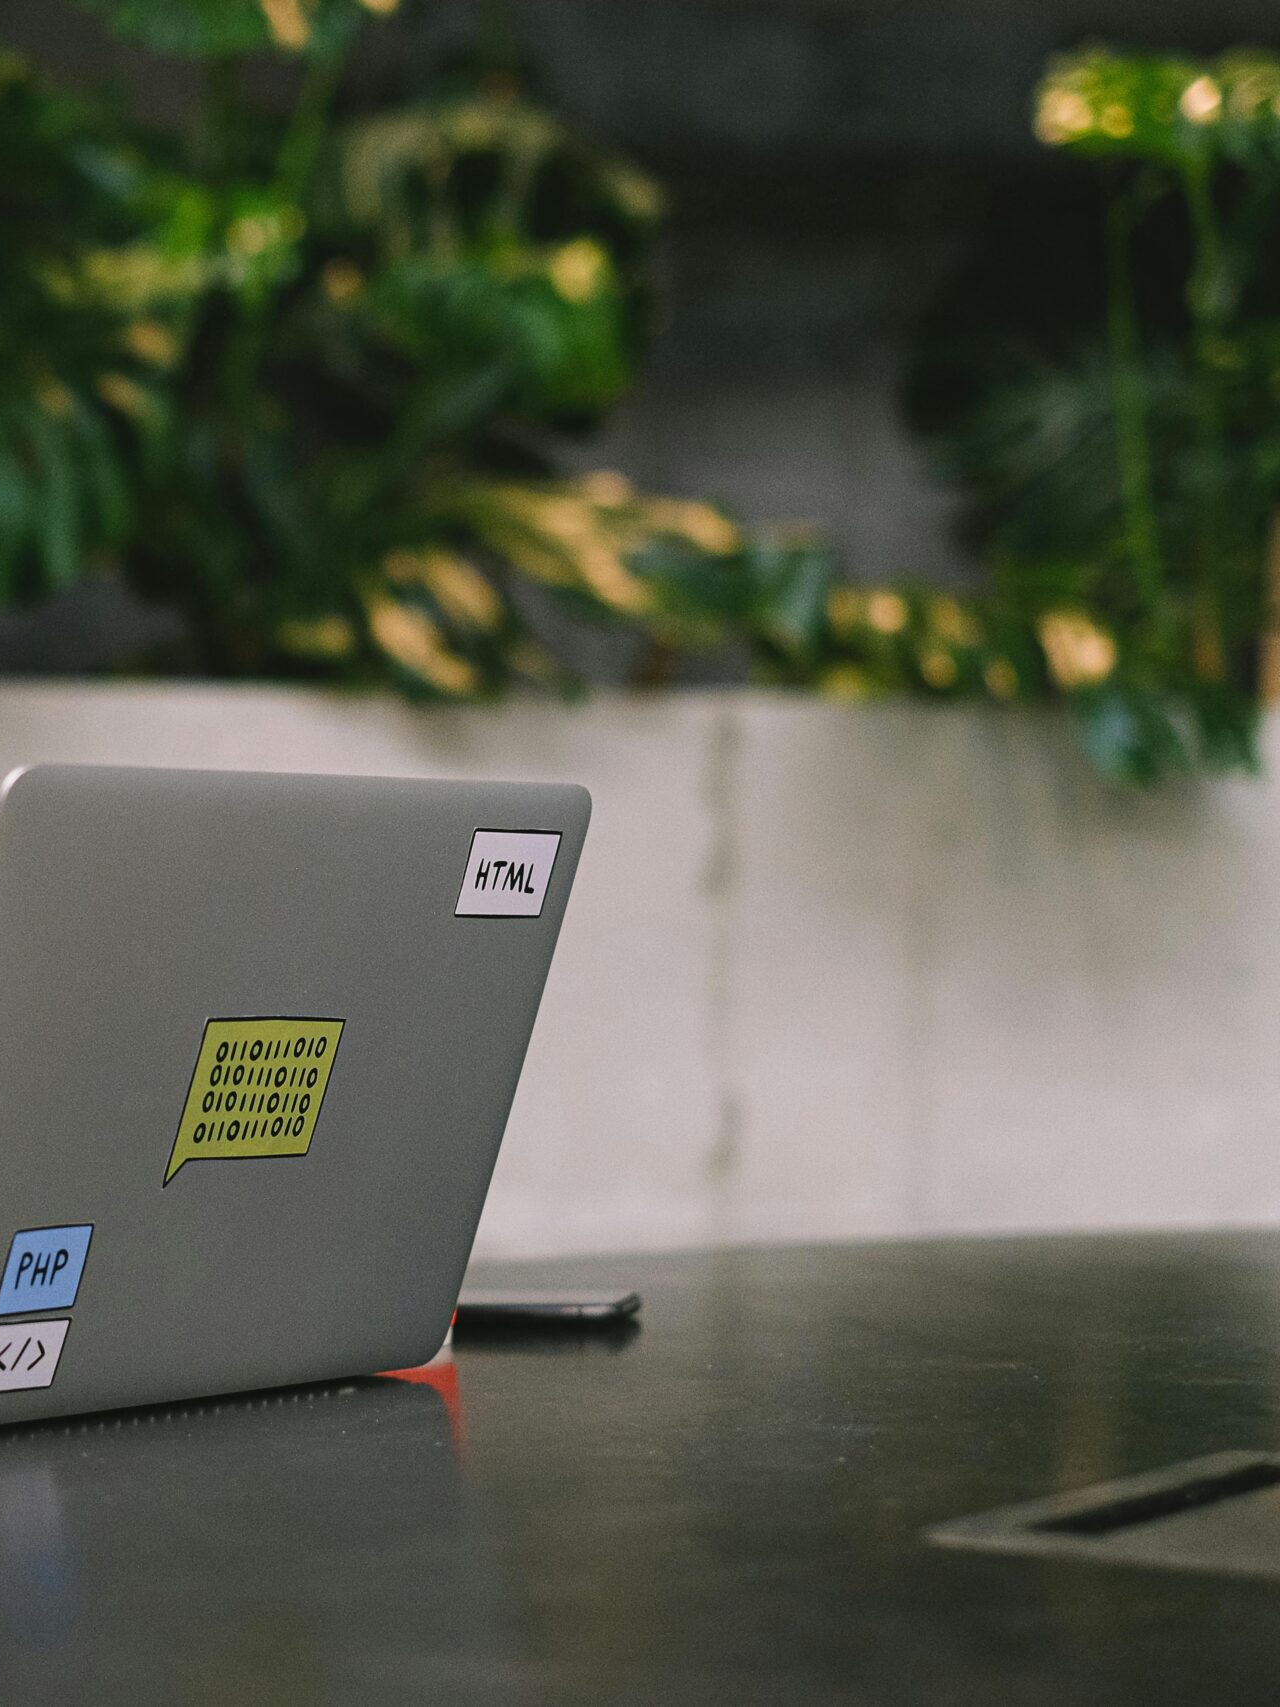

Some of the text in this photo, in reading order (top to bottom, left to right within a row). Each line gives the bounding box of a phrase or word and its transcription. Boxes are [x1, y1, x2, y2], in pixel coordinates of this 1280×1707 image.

[474, 858, 534, 894] HTML
[216, 1036, 327, 1063] 0110111010
[209, 1064, 318, 1088] 0101110110
[202, 1091, 310, 1114] 0101110110
[193, 1115, 305, 1143] 0110111010
[14, 1248, 69, 1290] PHP
